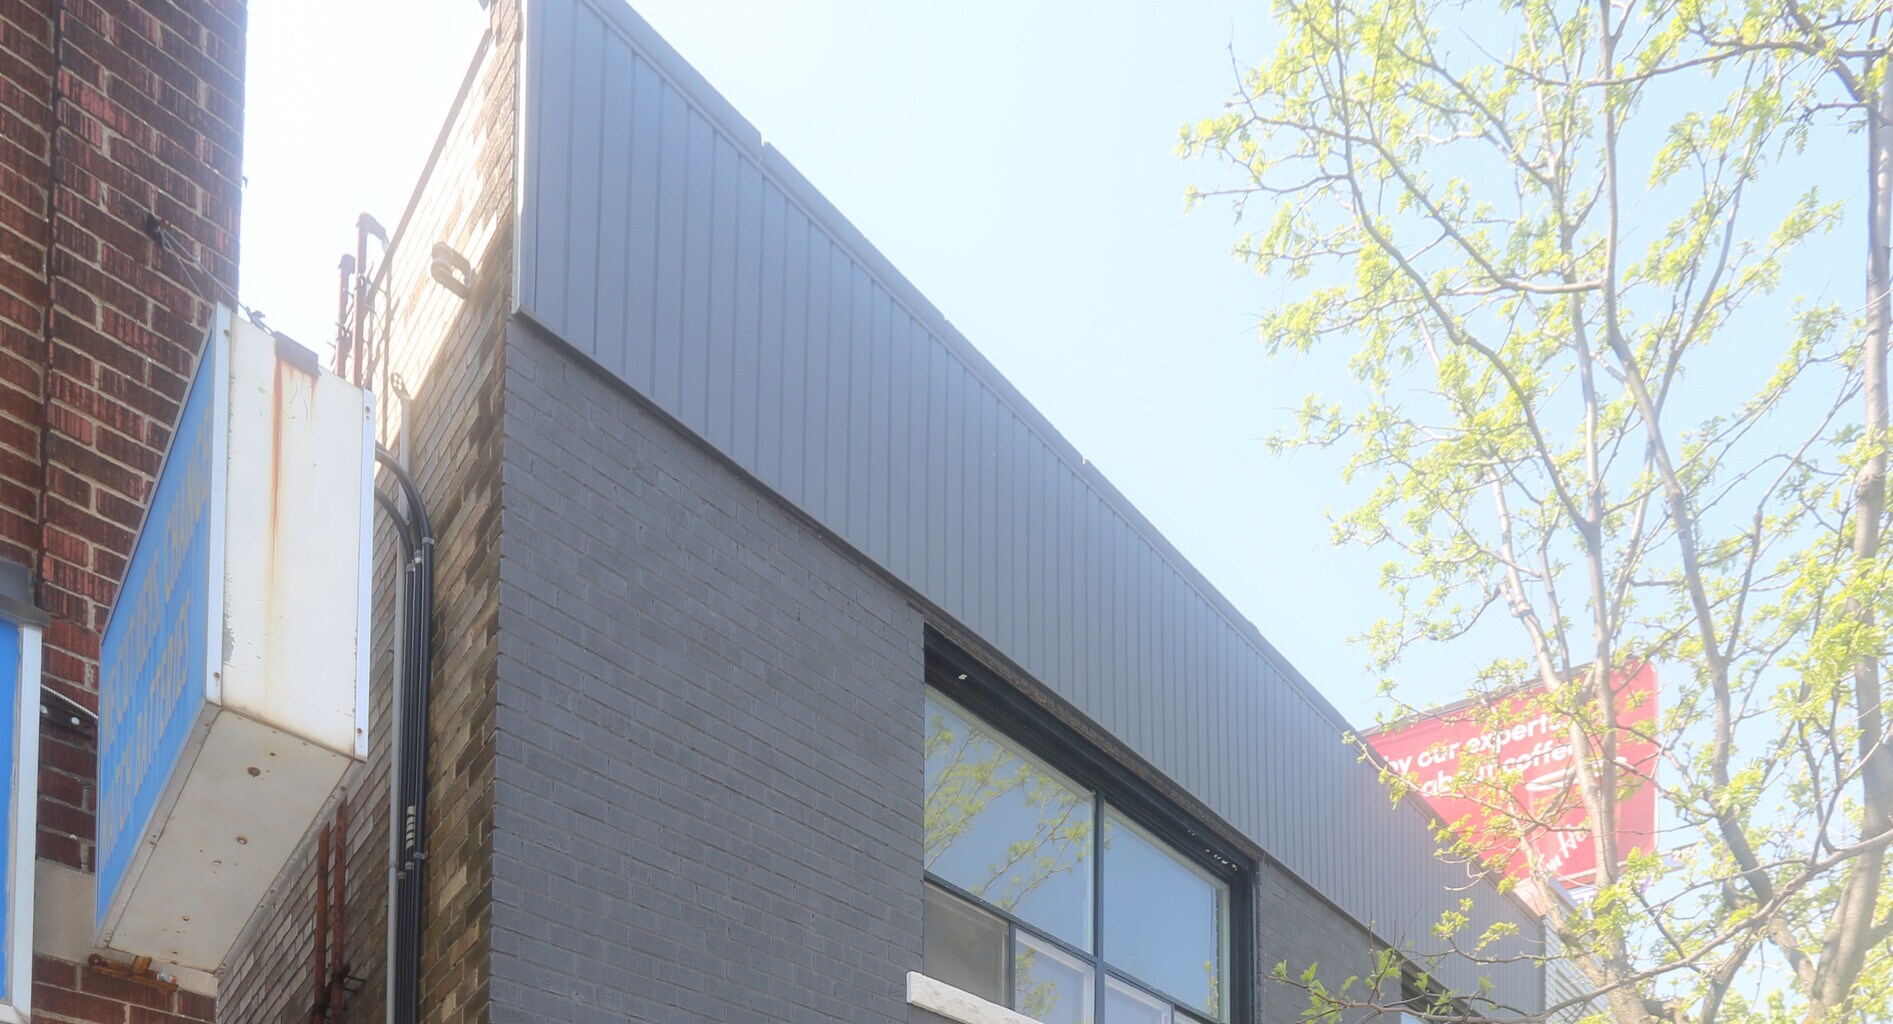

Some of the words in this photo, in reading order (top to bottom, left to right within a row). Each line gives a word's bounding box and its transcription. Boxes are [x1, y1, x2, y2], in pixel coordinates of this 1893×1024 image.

[102, 662, 116, 760] WE
[117, 612, 135, 727] CUT
[164, 408, 211, 604] CHANGE
[102, 734, 131, 873] WATCH
[134, 589, 190, 797] BATTERIES
[1417, 741, 1461, 767] our
[1420, 761, 1499, 797] abut
